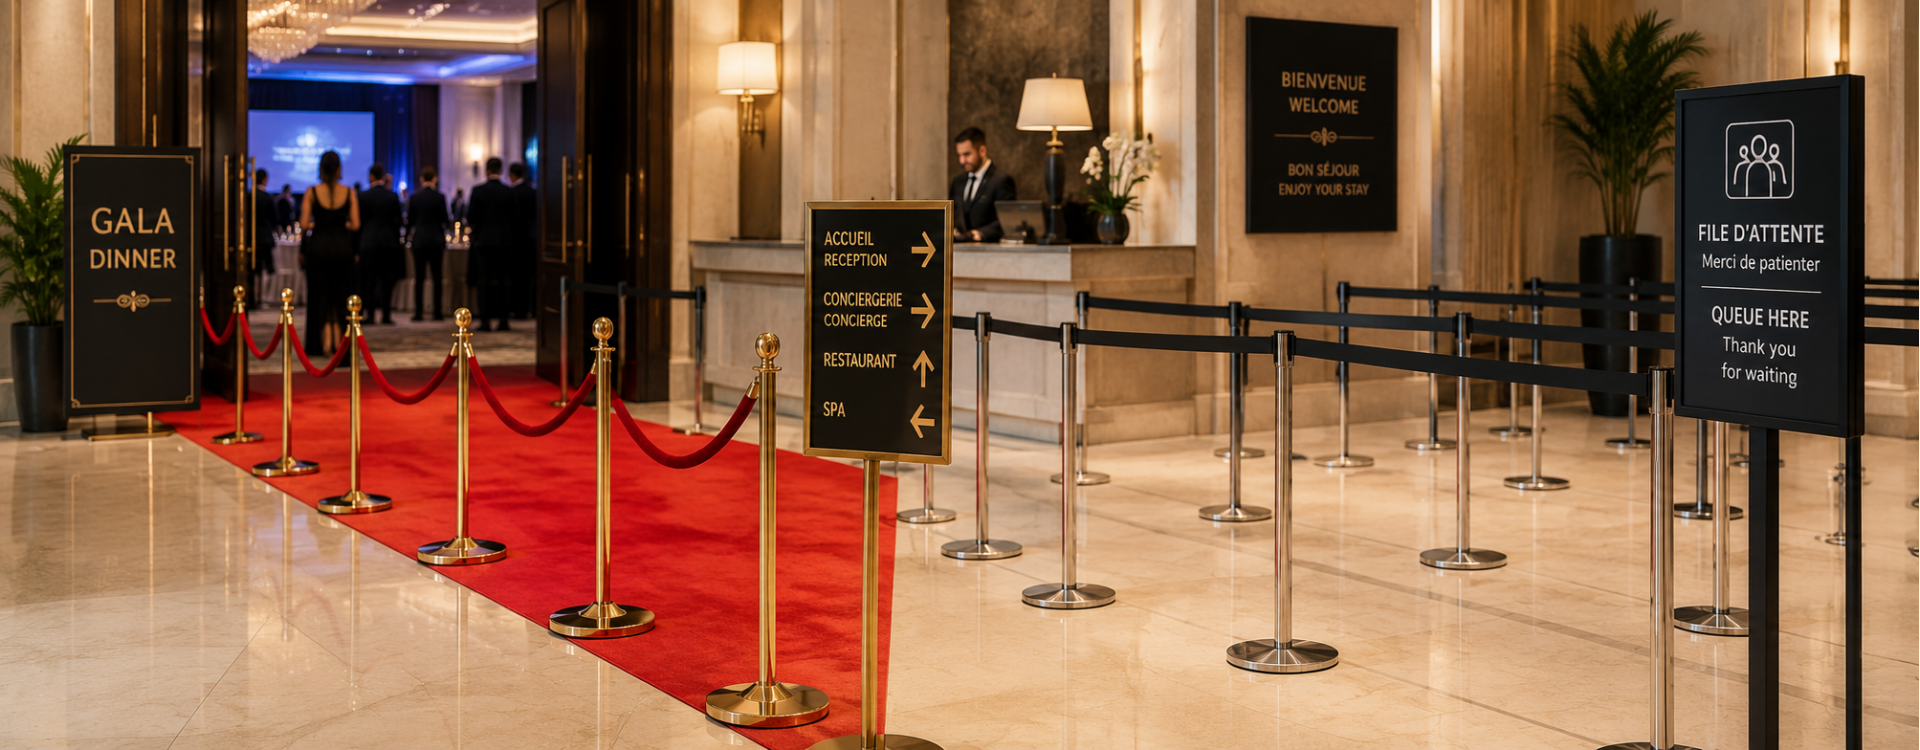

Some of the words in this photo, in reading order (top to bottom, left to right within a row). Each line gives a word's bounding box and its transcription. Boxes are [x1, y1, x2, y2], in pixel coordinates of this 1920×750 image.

[1281, 72, 1366, 91] BIENVENUE
[1288, 97, 1358, 114] WELCOME
[1288, 164, 1313, 176] BON
[1316, 161, 1359, 176] SÉJOUR
[1278, 183, 1312, 195] ENJOY
[1314, 184, 1342, 195] YOUR
[1345, 184, 1369, 195] STAY
[91, 207, 174, 234] GALA
[823, 231, 874, 245] ACCUEIL
[1698, 224, 1728, 241] FILE
[1734, 225, 1823, 243] D'ATTENTE
[90, 249, 176, 269] DINNER
[824, 253, 887, 266] RECEPTION
[1702, 254, 1735, 268] Merci
[1739, 254, 1755, 269] de
[1759, 255, 1820, 273] patienter
[823, 292, 902, 307] CONCIERGERIE
[823, 314, 887, 327] CONCIERGE
[1711, 306, 1763, 325] QUEUE
[1768, 309, 1809, 328] HERE
[1722, 336, 1765, 354] Thank
[1768, 344, 1795, 359] you
[823, 353, 896, 368] RESTAURANT
[1721, 362, 1741, 379] for
[1744, 366, 1797, 388] waiting
[823, 402, 845, 417] SPA
